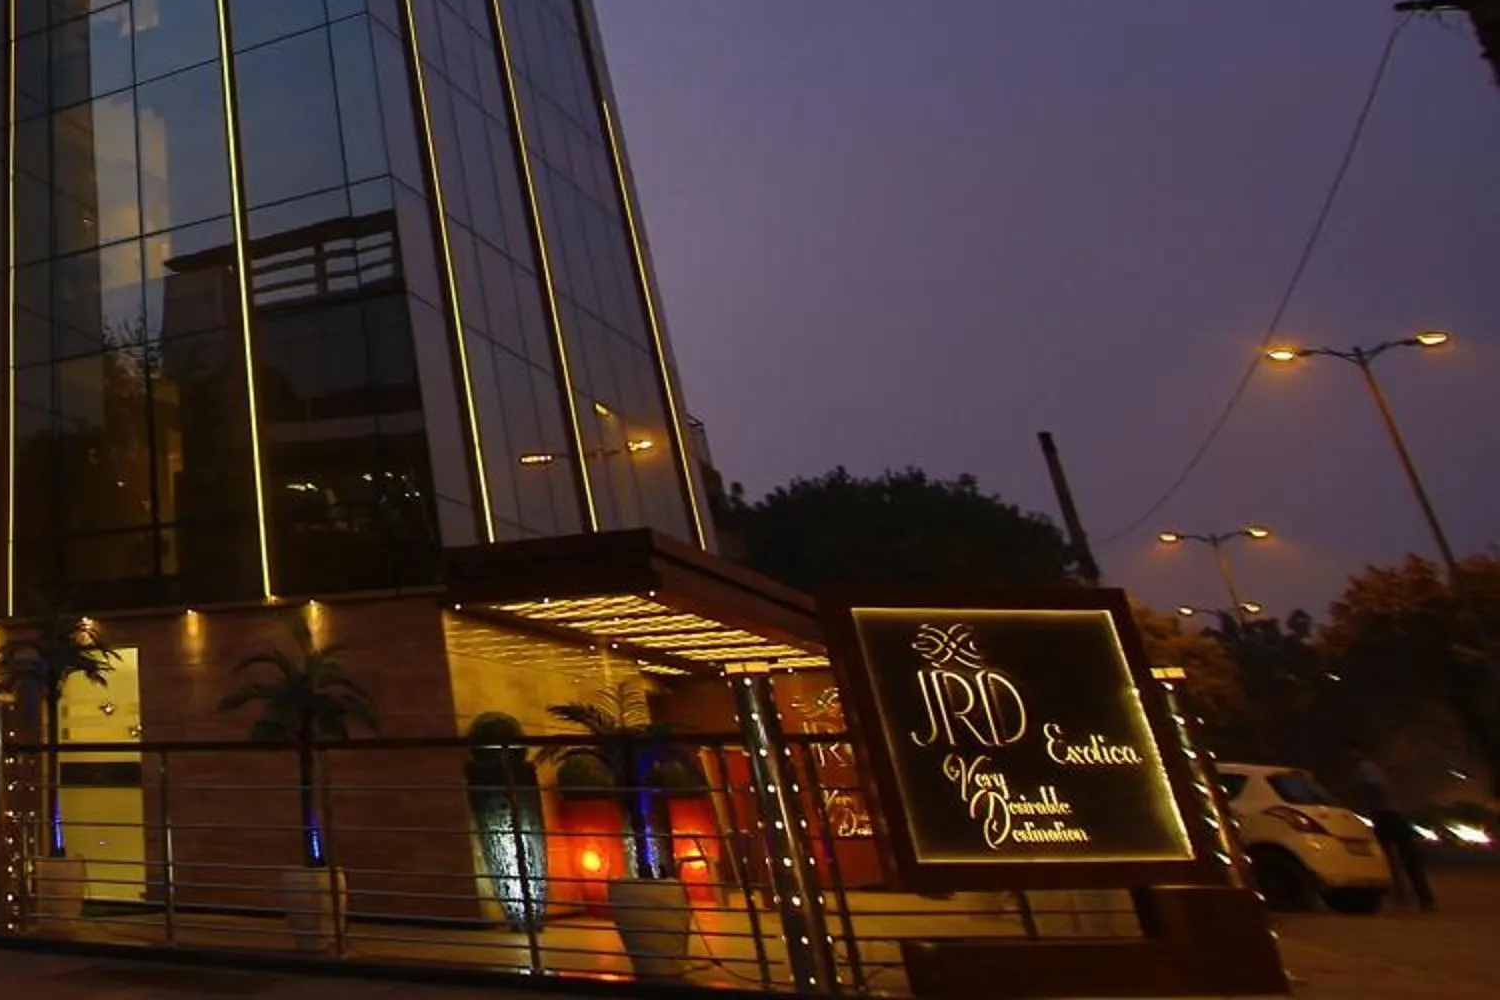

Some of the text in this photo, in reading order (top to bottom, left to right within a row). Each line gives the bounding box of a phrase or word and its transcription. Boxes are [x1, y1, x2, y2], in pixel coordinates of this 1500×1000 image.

[910, 669, 1027, 747] JRD
[1043, 723, 1143, 765] Exotica
[943, 753, 1010, 802] Very
